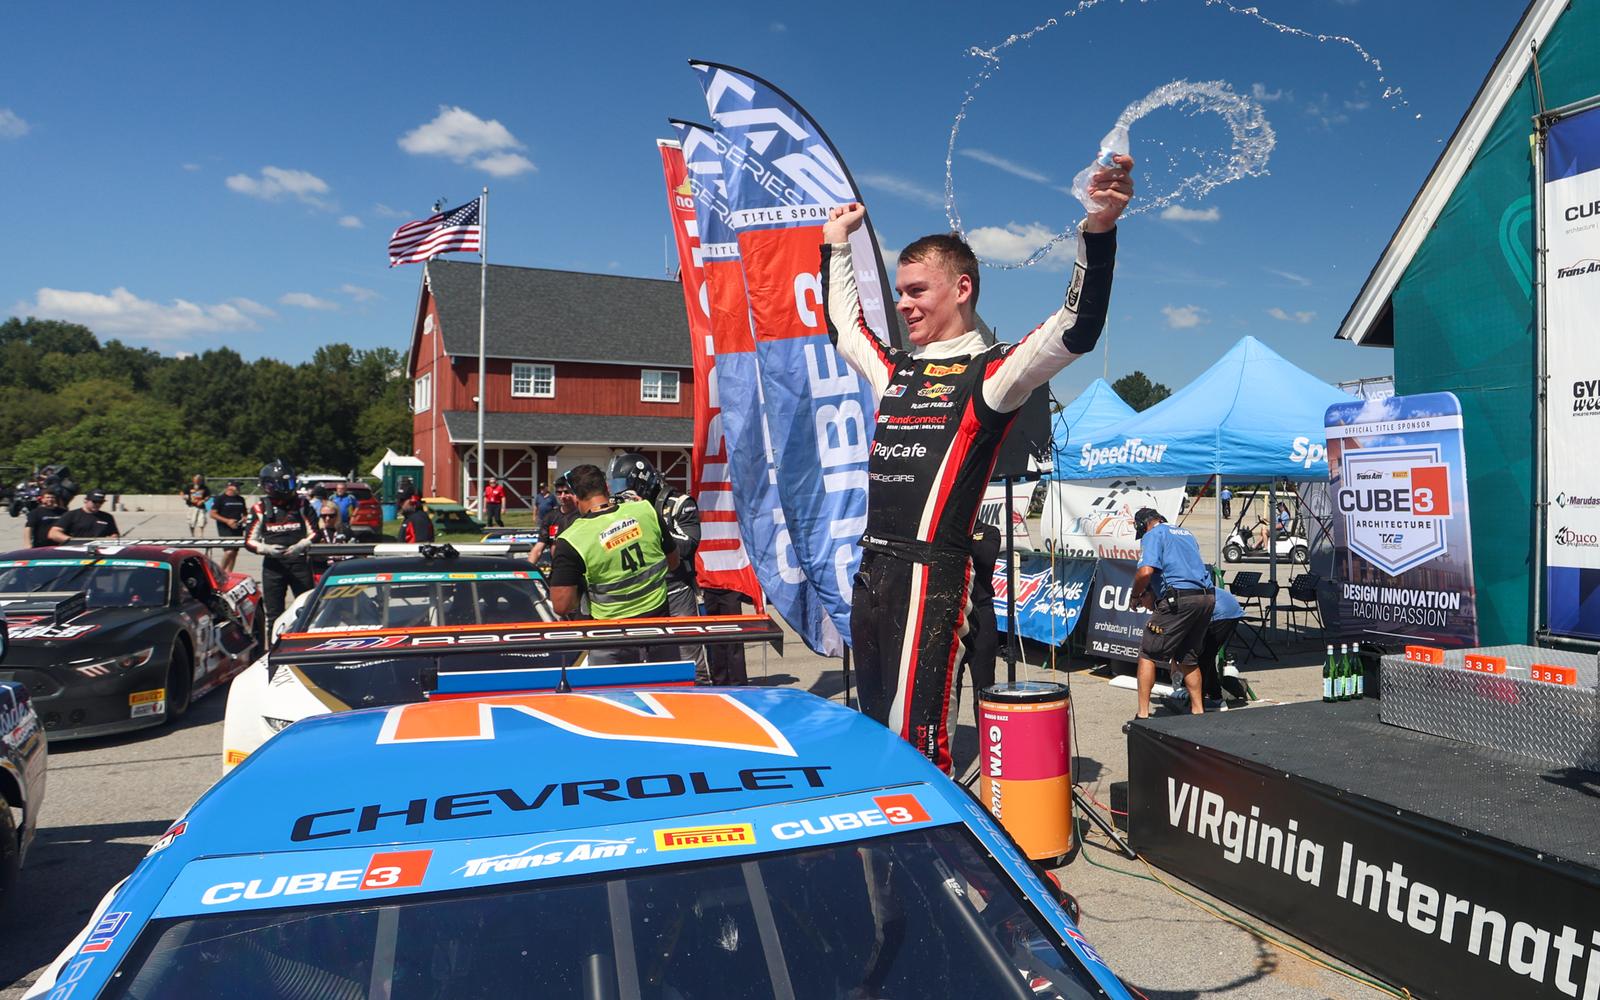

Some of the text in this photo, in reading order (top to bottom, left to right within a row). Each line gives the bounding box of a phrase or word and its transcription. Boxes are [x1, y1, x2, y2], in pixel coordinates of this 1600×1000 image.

[714, 130, 806, 208] SERIES
[742, 210, 783, 224] TITLE
[1557, 266, 1585, 279] Trans
[918, 386, 955, 397] SUNOCO
[1573, 380, 1600, 398] GY
[1376, 424, 1394, 432] TITLE
[1398, 421, 1431, 430] SPONSOR
[873, 443, 927, 460] PayCafe
[1080, 438, 1168, 471] SpeedTour
[1340, 488, 1434, 512] CUBE3
[600, 523, 622, 540] Trans
[605, 528, 640, 549] PIRELLI
[1566, 530, 1597, 543] Duco
[620, 542, 646, 574] 47
[1344, 583, 1460, 610] DESIGN INNOVATION
[1353, 601, 1447, 627] RACING PASSION
[1094, 621, 1128, 634] architecture
[1092, 641, 1139, 658] TA2 SERIES
[990, 725, 1002, 778] GYM
[290, 765, 832, 842] CHEVROLET
[772, 805, 913, 841] CUBE3
[1167, 776, 1325, 888] VIRginia
[463, 827, 745, 878] Trans Am BY PIRELLI
[201, 865, 401, 907] CUBE3
